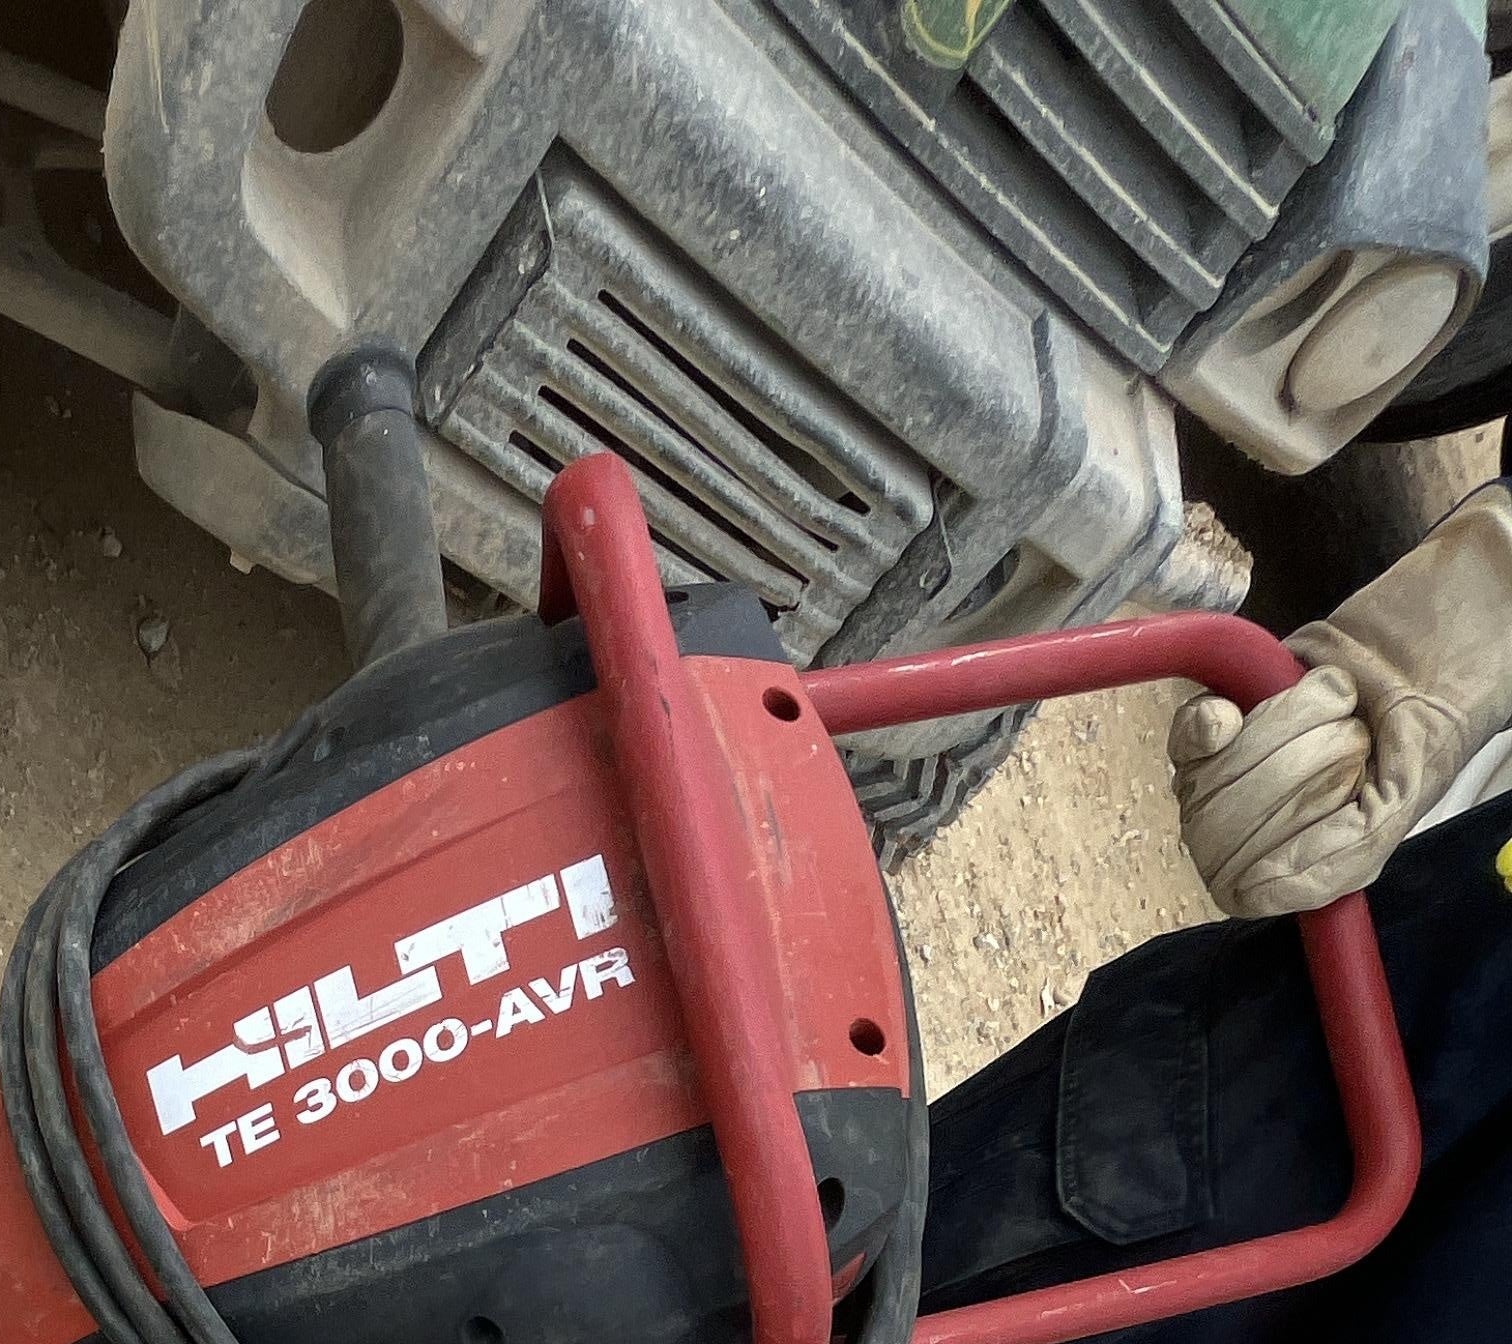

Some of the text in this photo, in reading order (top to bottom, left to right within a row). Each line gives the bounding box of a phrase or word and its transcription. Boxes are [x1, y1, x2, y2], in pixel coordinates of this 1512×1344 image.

[146, 853, 619, 1136] HILTI
[199, 946, 636, 1168] TE 3000-AVR
